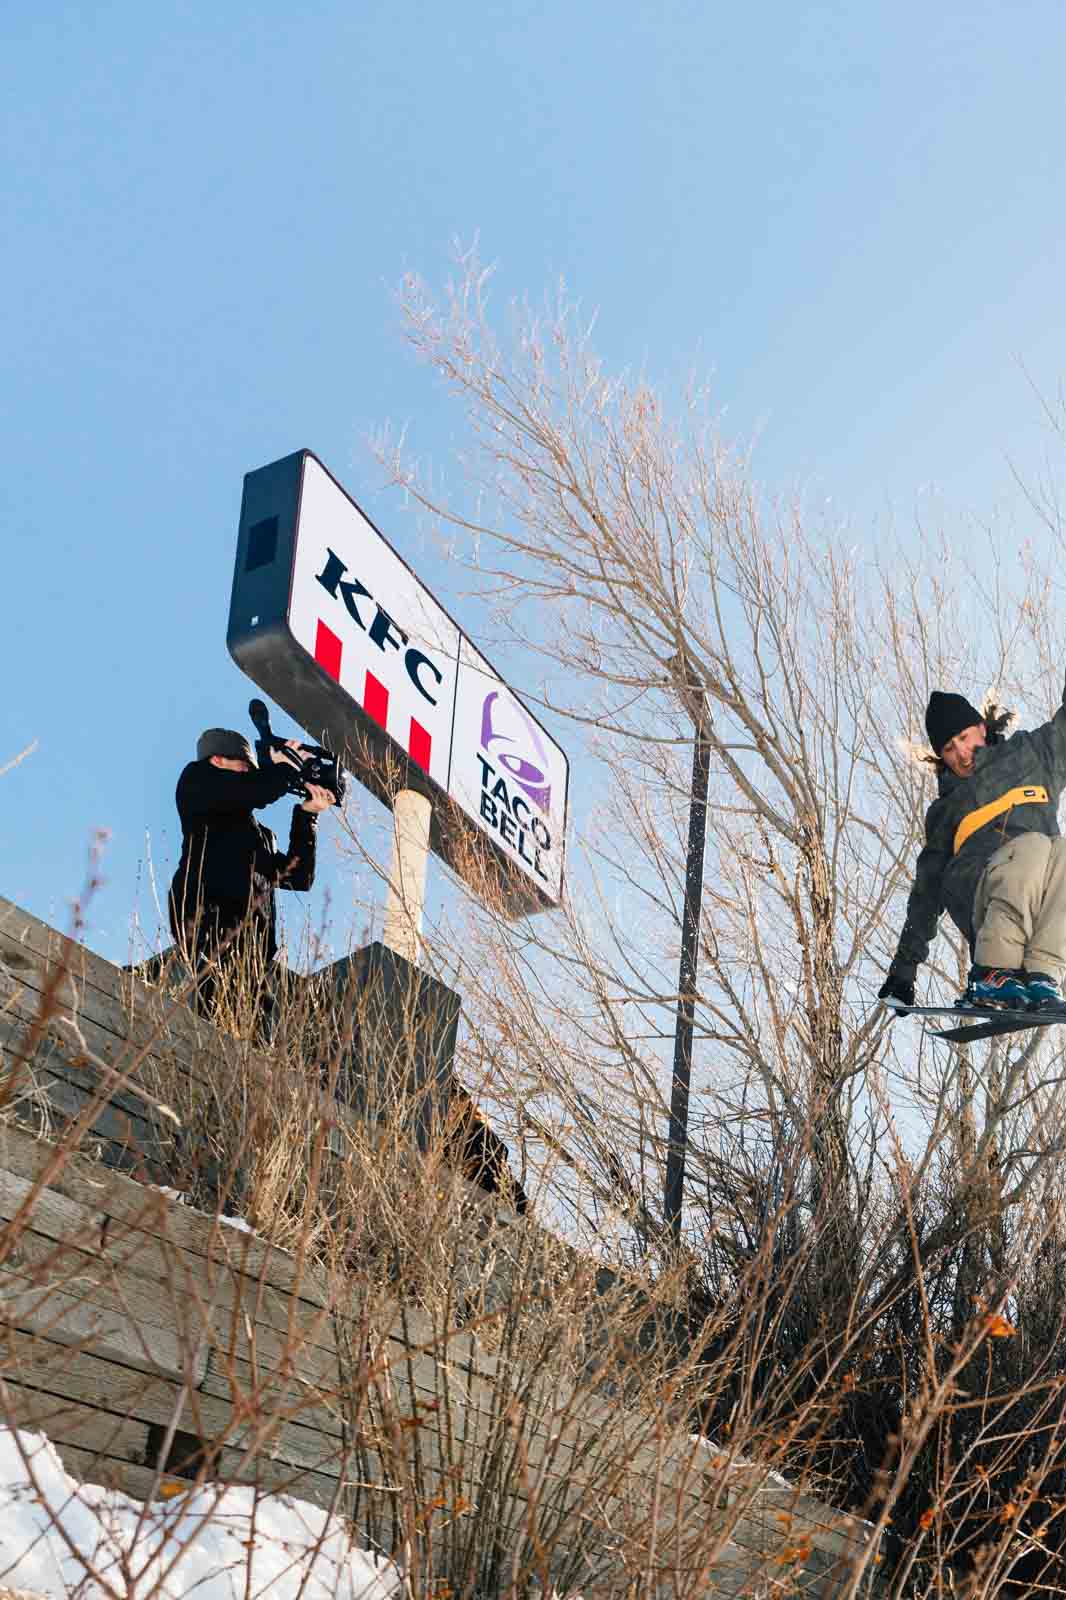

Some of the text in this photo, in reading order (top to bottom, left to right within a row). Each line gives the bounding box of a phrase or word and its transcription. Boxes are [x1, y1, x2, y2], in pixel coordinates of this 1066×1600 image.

[315, 547, 443, 706] KFC
[476, 752, 551, 851] TACO
[480, 789, 548, 881] BELL
